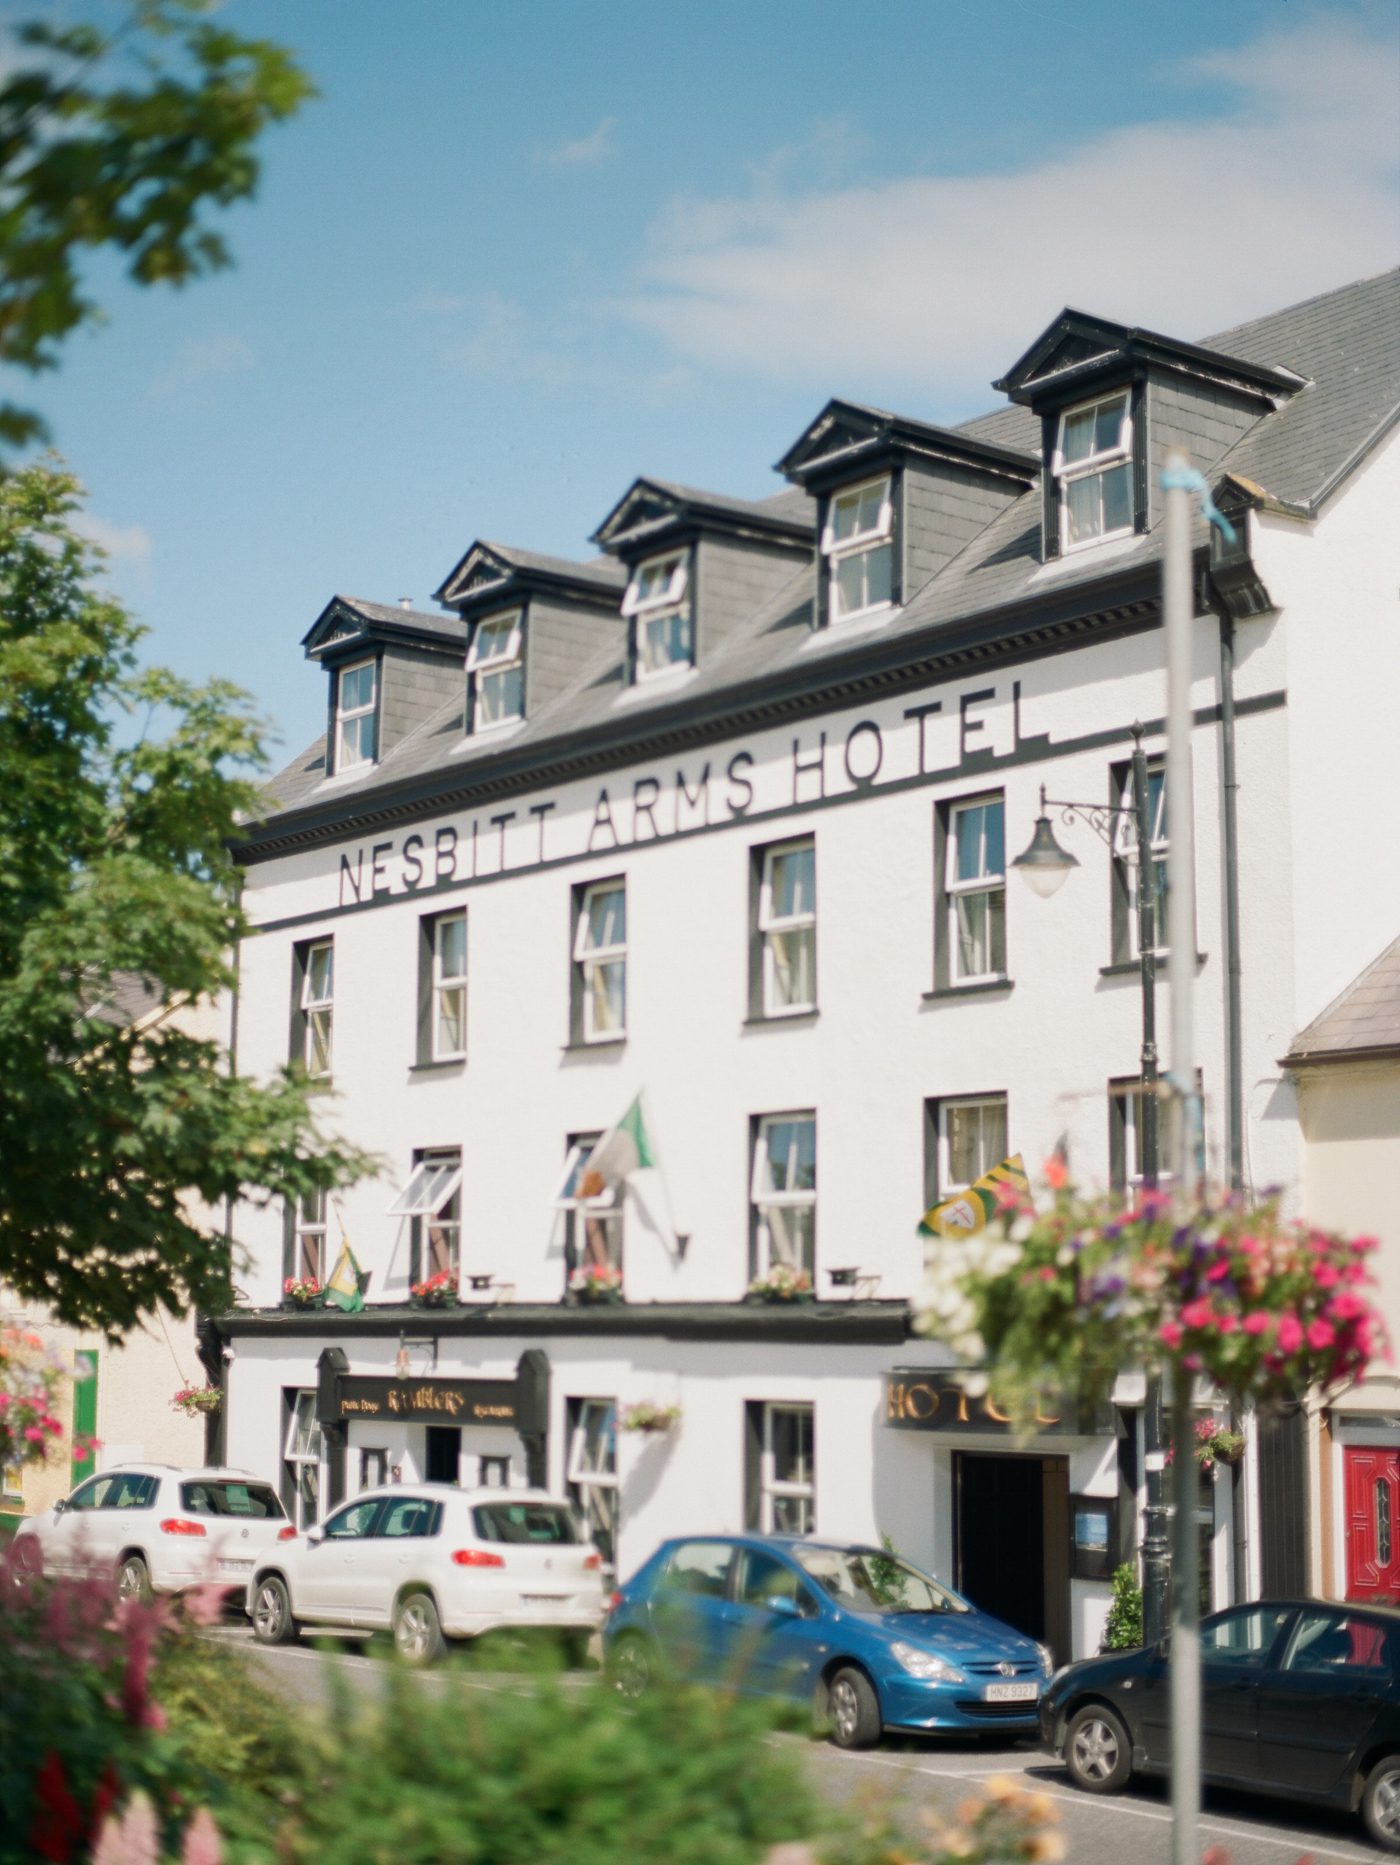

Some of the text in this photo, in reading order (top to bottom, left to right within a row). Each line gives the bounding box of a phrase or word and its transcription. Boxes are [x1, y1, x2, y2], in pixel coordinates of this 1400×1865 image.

[338, 680, 1052, 907] NESBITT ARMS HOTEL
